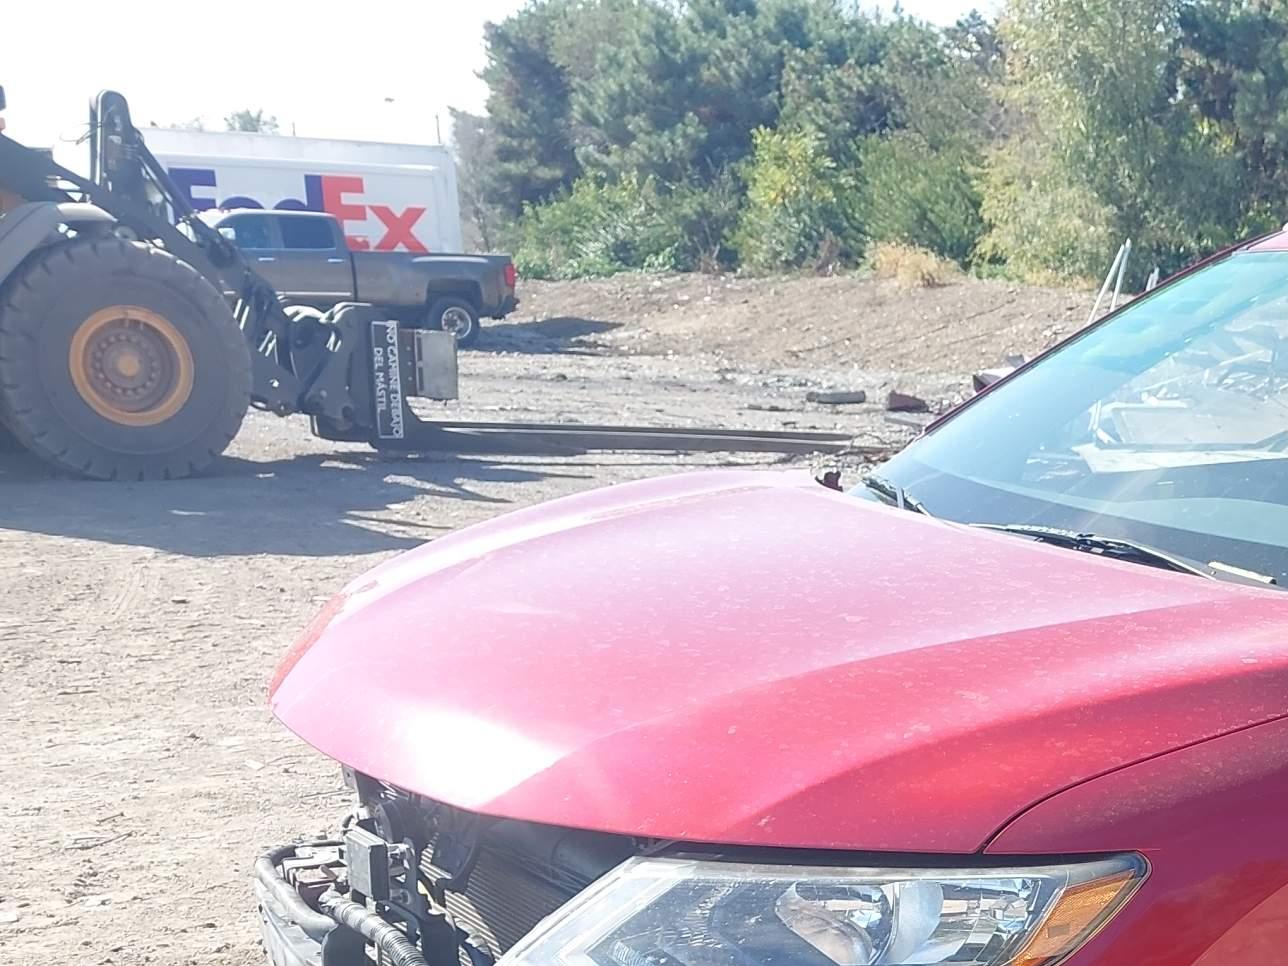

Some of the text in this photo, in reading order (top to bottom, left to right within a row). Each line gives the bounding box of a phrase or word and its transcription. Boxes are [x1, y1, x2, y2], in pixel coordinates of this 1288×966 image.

[168, 167, 429, 254] FEx
[386, 322, 396, 343] NO
[374, 347, 384, 369] DEL
